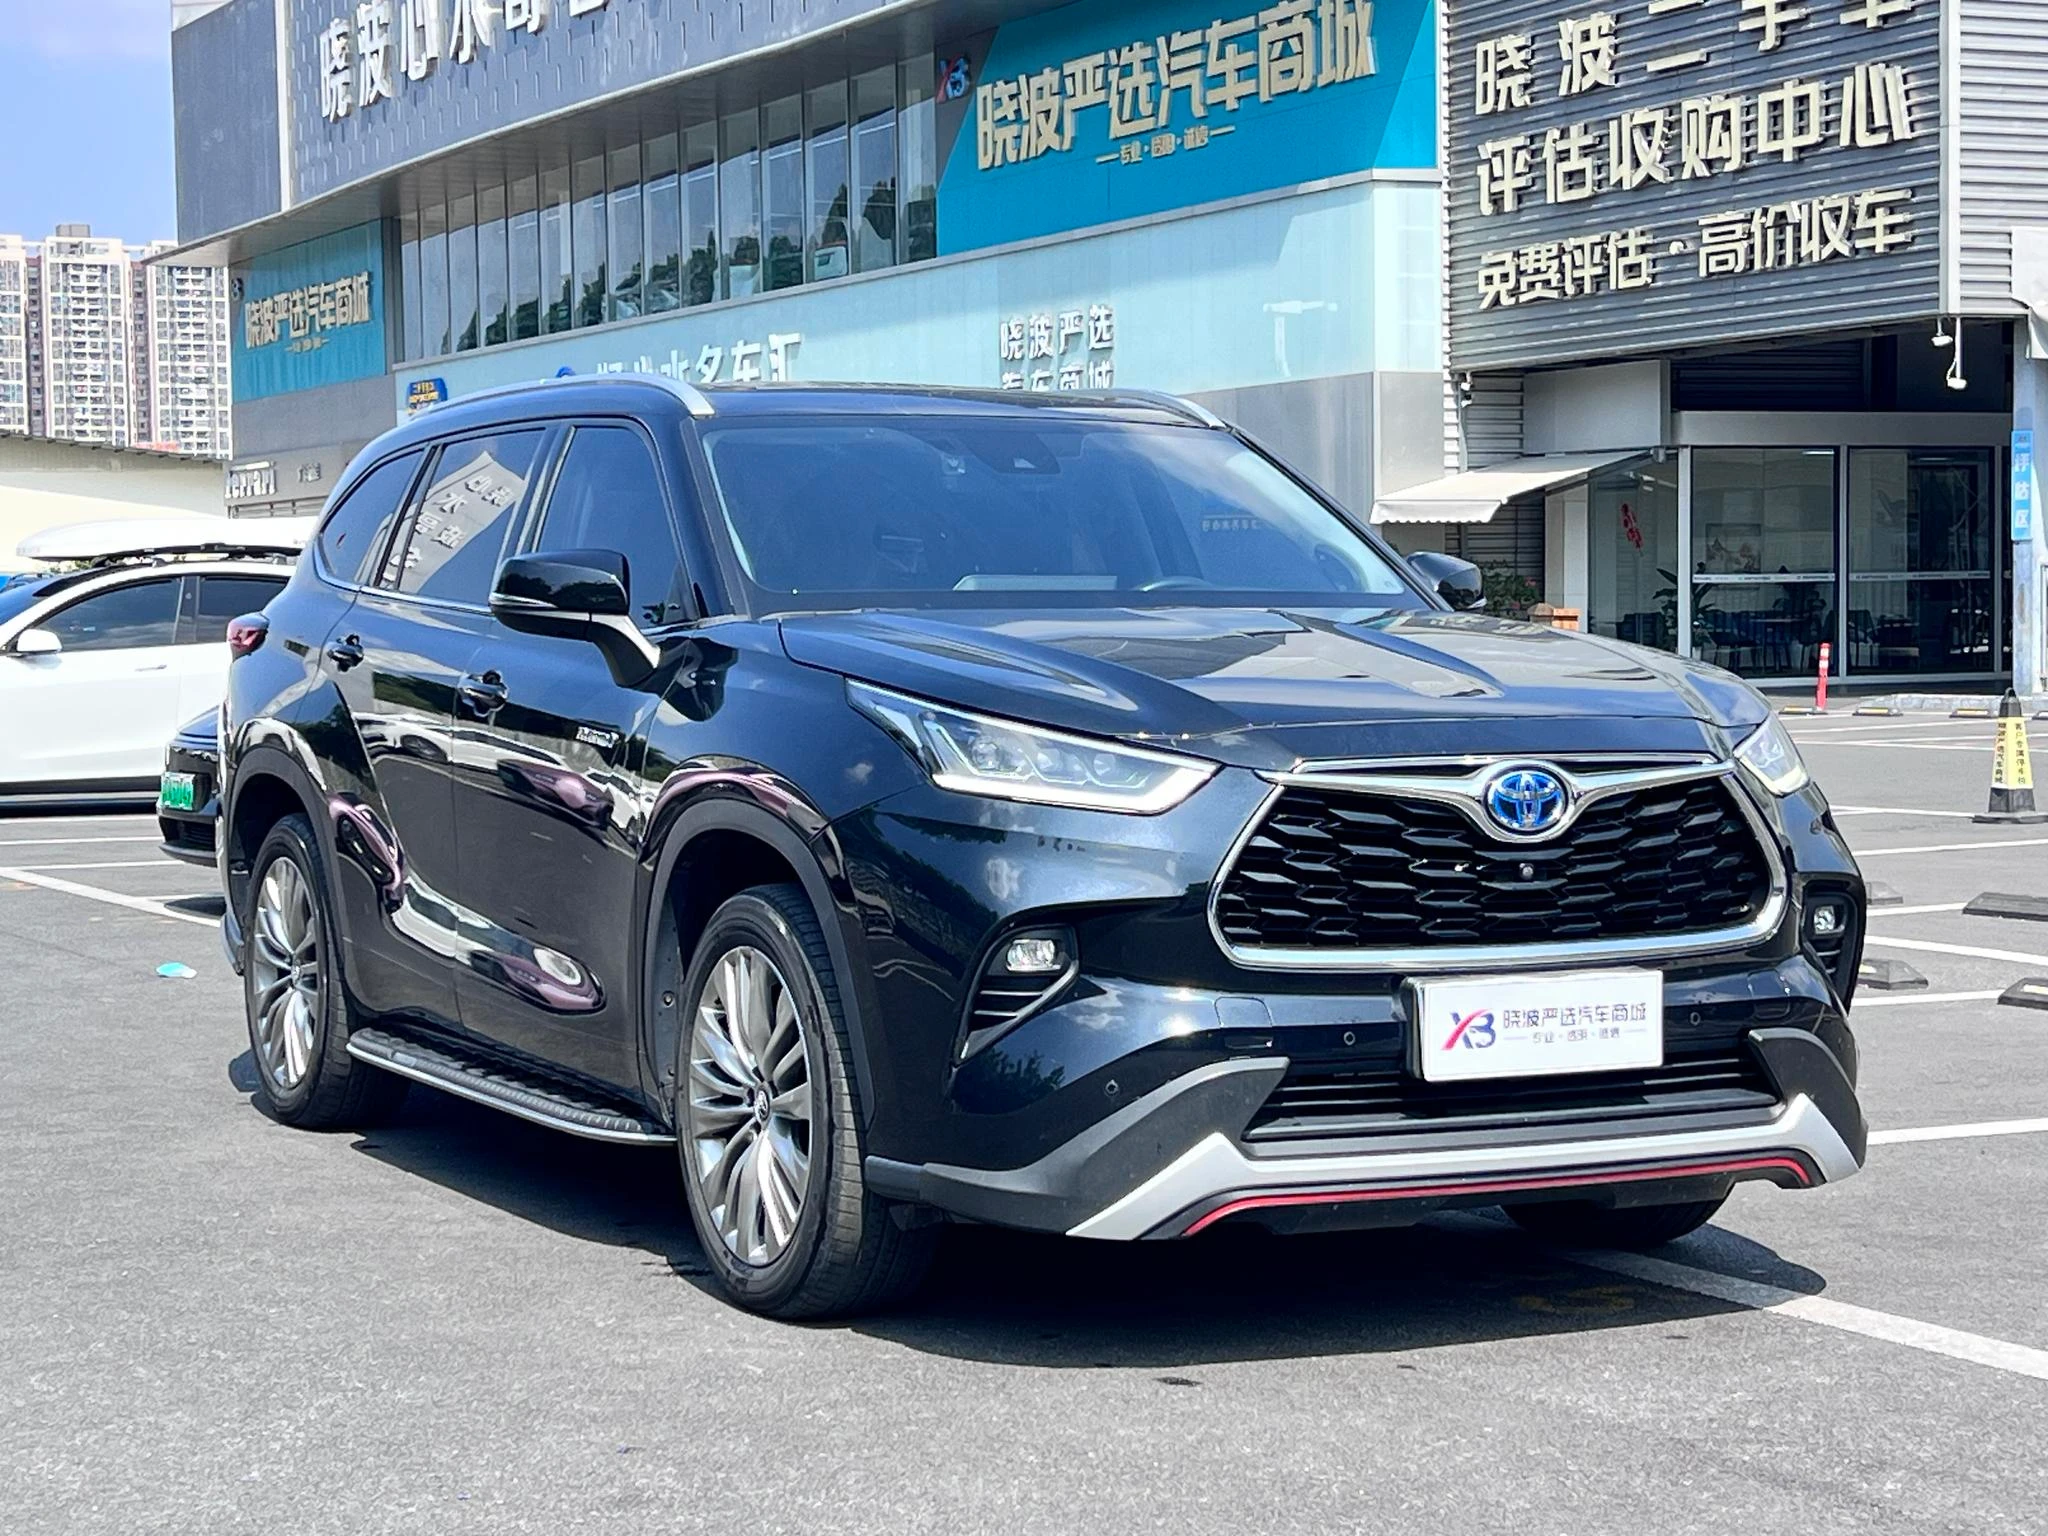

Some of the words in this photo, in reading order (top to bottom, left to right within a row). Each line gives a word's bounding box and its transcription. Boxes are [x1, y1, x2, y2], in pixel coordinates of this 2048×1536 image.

[320, 0, 606, 122] 晓波心水
[976, 0, 1377, 171] 晓波严选汽车商城
[1476, 62, 1914, 217] 评估收购中心
[244, 270, 370, 349] 晓波严选汽车商城
[1000, 303, 1114, 361] 晓波严选
[2014, 452, 2031, 529] 评估区
[1503, 1002, 1647, 1030] 晓波严选汽车商城
